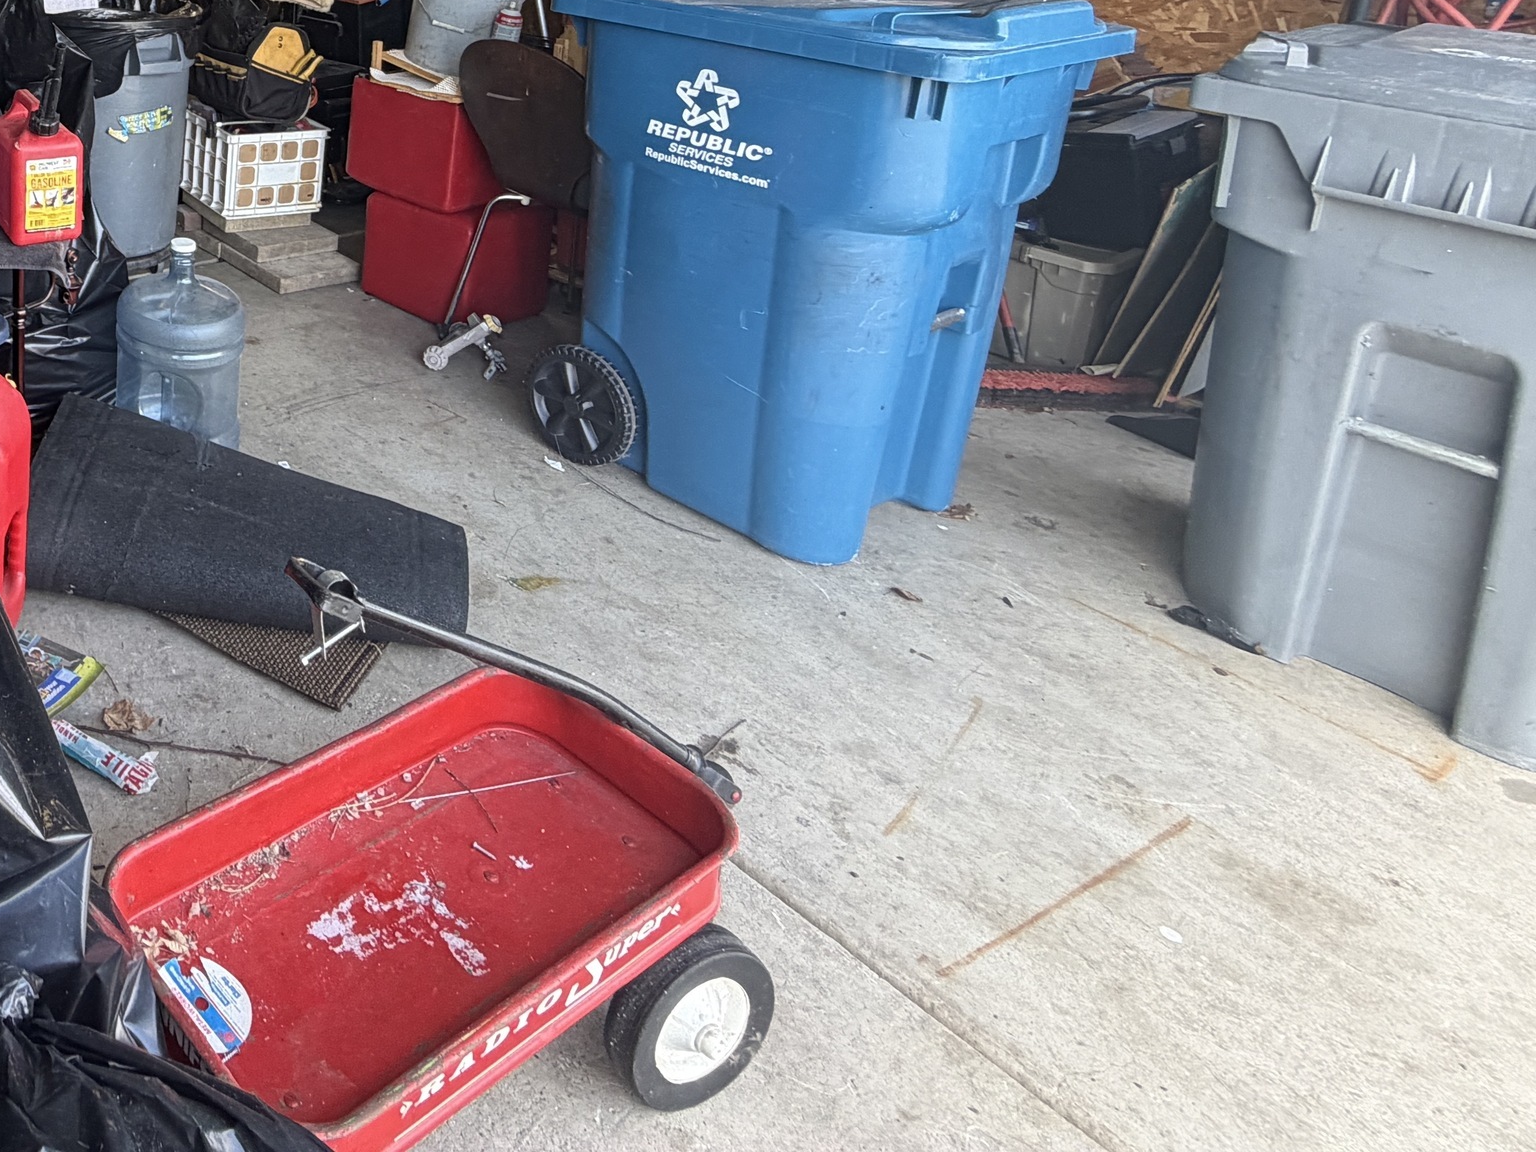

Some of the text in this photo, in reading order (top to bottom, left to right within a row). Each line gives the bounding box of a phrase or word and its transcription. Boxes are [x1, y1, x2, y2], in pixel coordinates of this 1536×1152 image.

[646, 119, 764, 161] REPUBLIC
[668, 142, 734, 168] SERVICES
[30, 174, 73, 189] GASOLINE
[644, 146, 770, 189] RepublicServices.com
[414, 988, 563, 1108] RADIO
